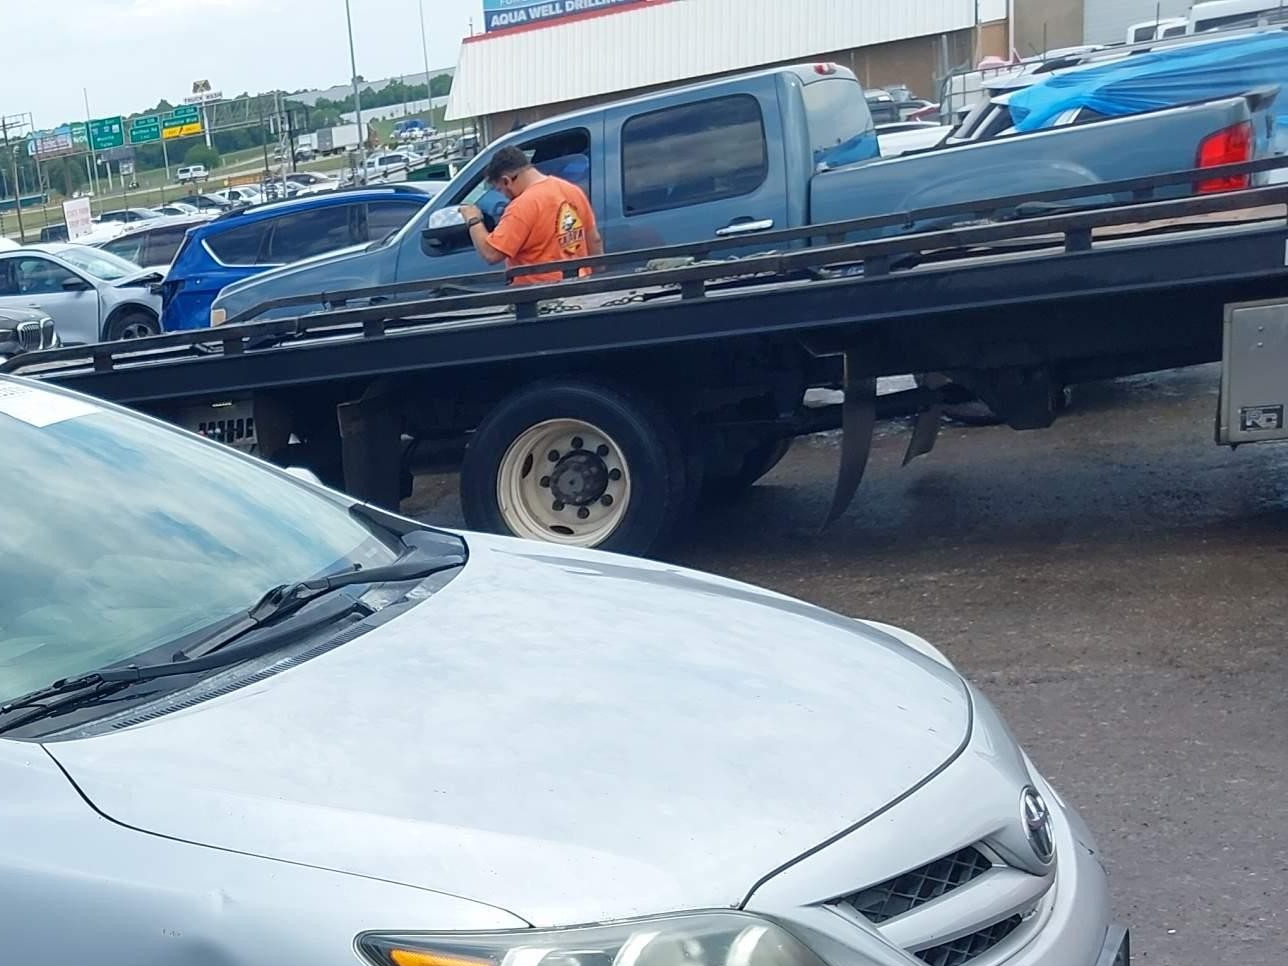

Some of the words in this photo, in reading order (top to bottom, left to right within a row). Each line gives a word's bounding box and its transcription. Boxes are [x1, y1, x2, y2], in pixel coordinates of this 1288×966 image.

[490, 9, 527, 27] AQUA
[528, 2, 563, 19] WELL
[565, 0, 624, 11] DRILL
